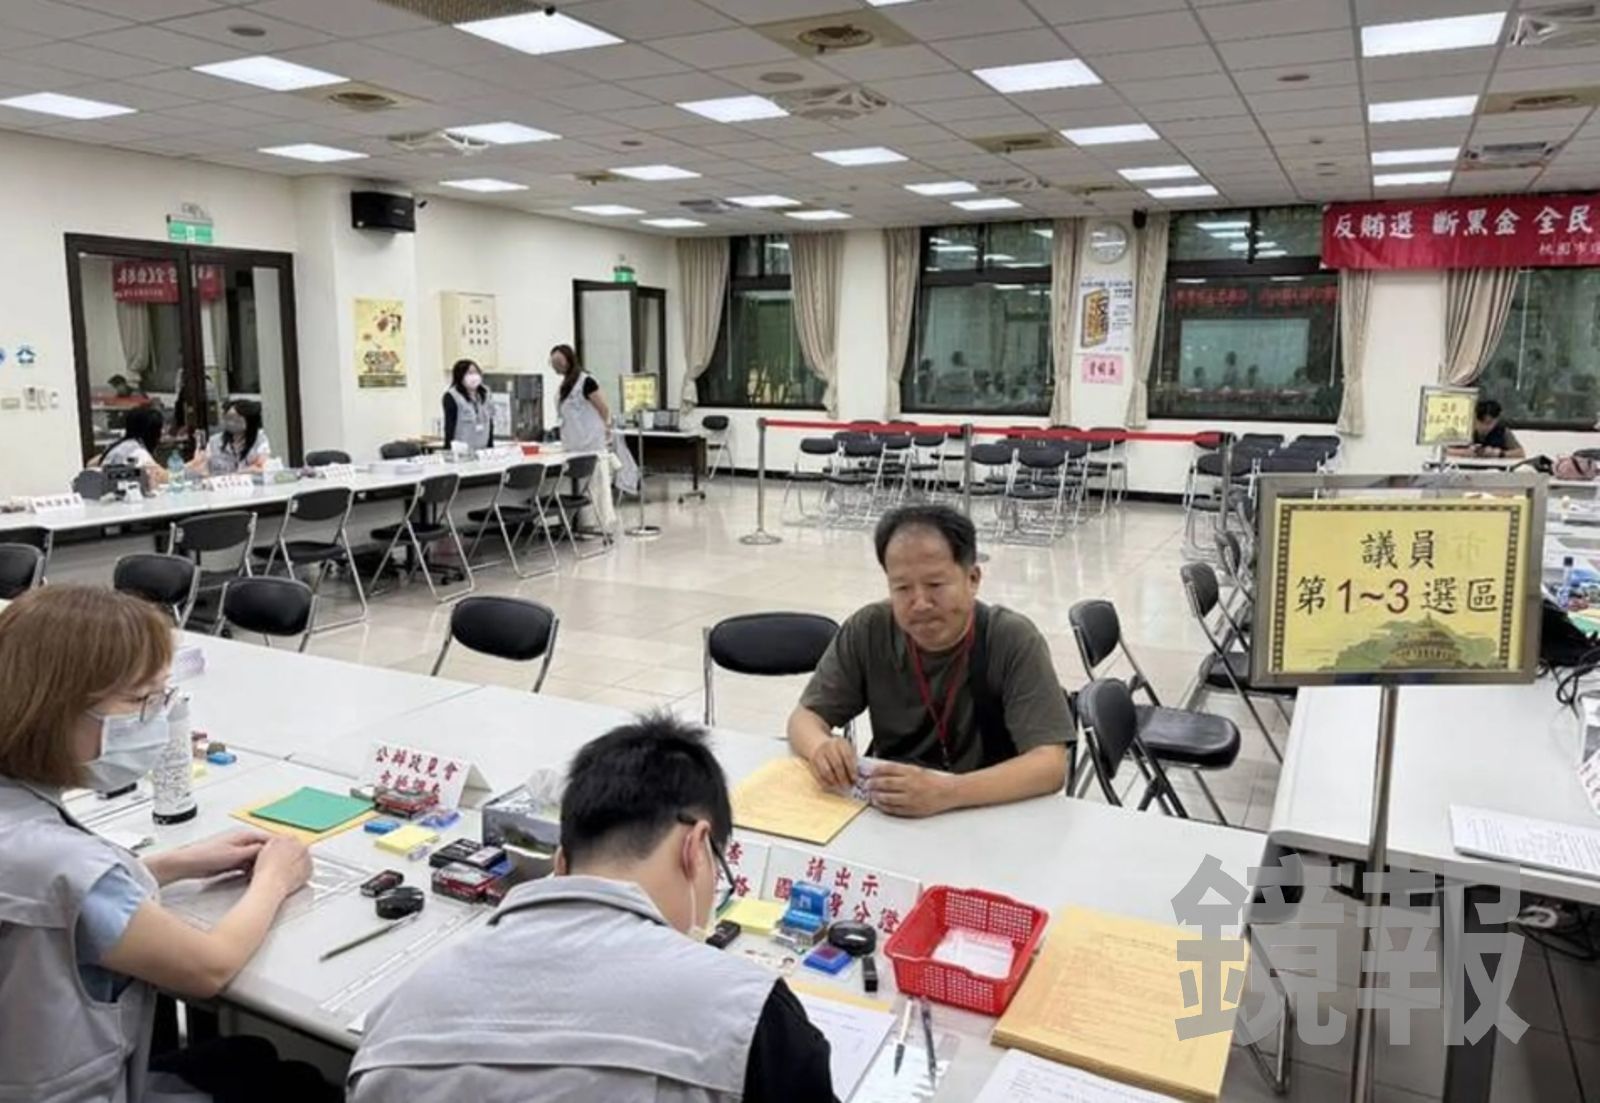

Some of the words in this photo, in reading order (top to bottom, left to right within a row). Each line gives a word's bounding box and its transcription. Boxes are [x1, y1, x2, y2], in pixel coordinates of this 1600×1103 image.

[1332, 211, 1415, 239] 反賄選
[1431, 209, 1521, 237] 斷黑金
[1532, 205, 1594, 235] 全民
[1361, 530, 1436, 570] 議員
[1295, 575, 1499, 616] 第1~3選區
[376, 746, 459, 781] 公辦政見會
[806, 856, 879, 898] 請出示
[774, 876, 901, 935] 國身分證
